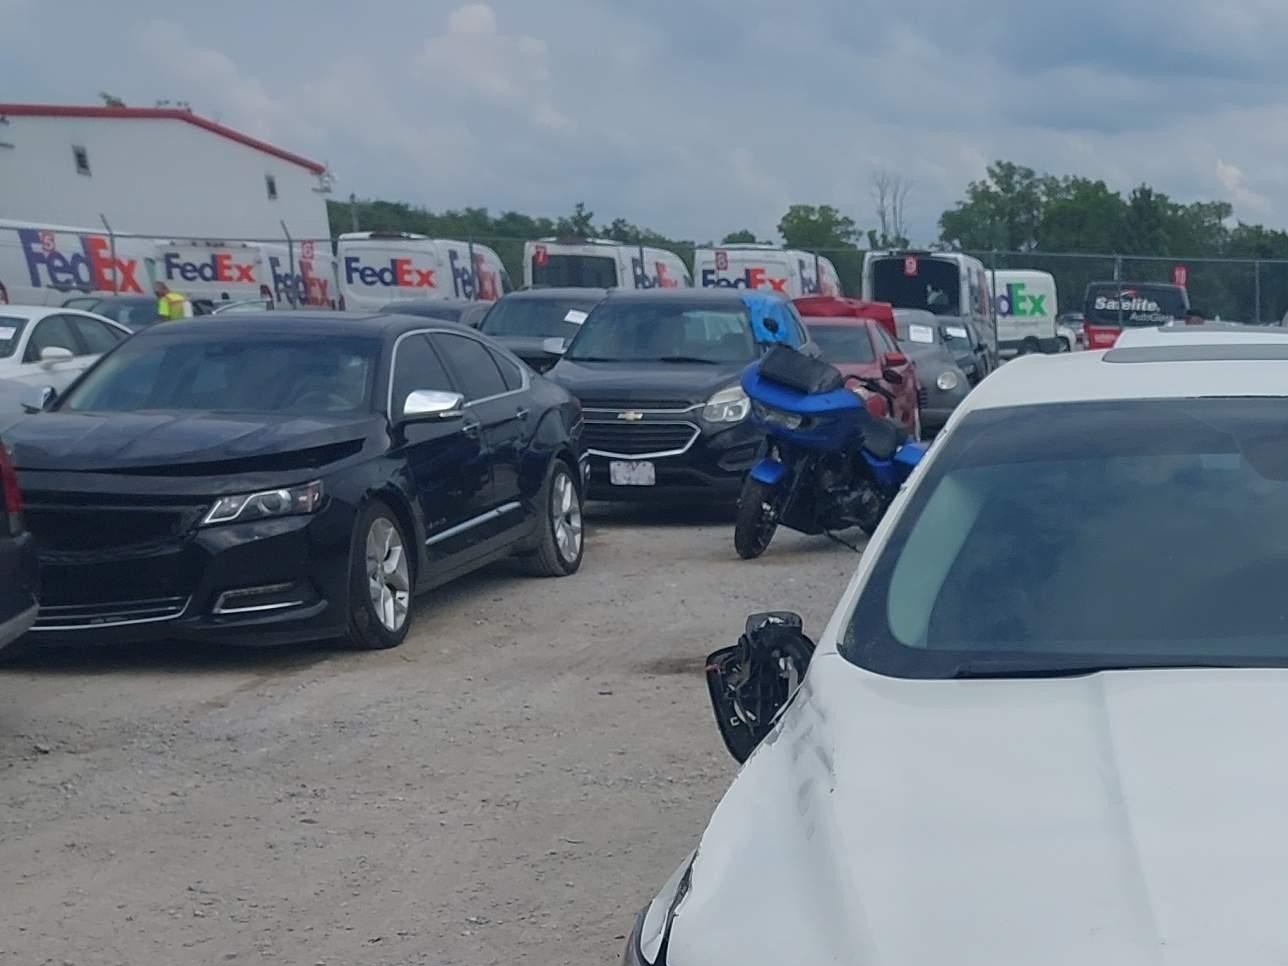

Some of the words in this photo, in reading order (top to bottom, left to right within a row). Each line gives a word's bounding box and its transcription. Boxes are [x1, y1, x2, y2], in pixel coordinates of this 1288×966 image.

[18, 228, 144, 294] FedEx
[164, 252, 256, 283] FedEx
[344, 256, 436, 288] FedEx
